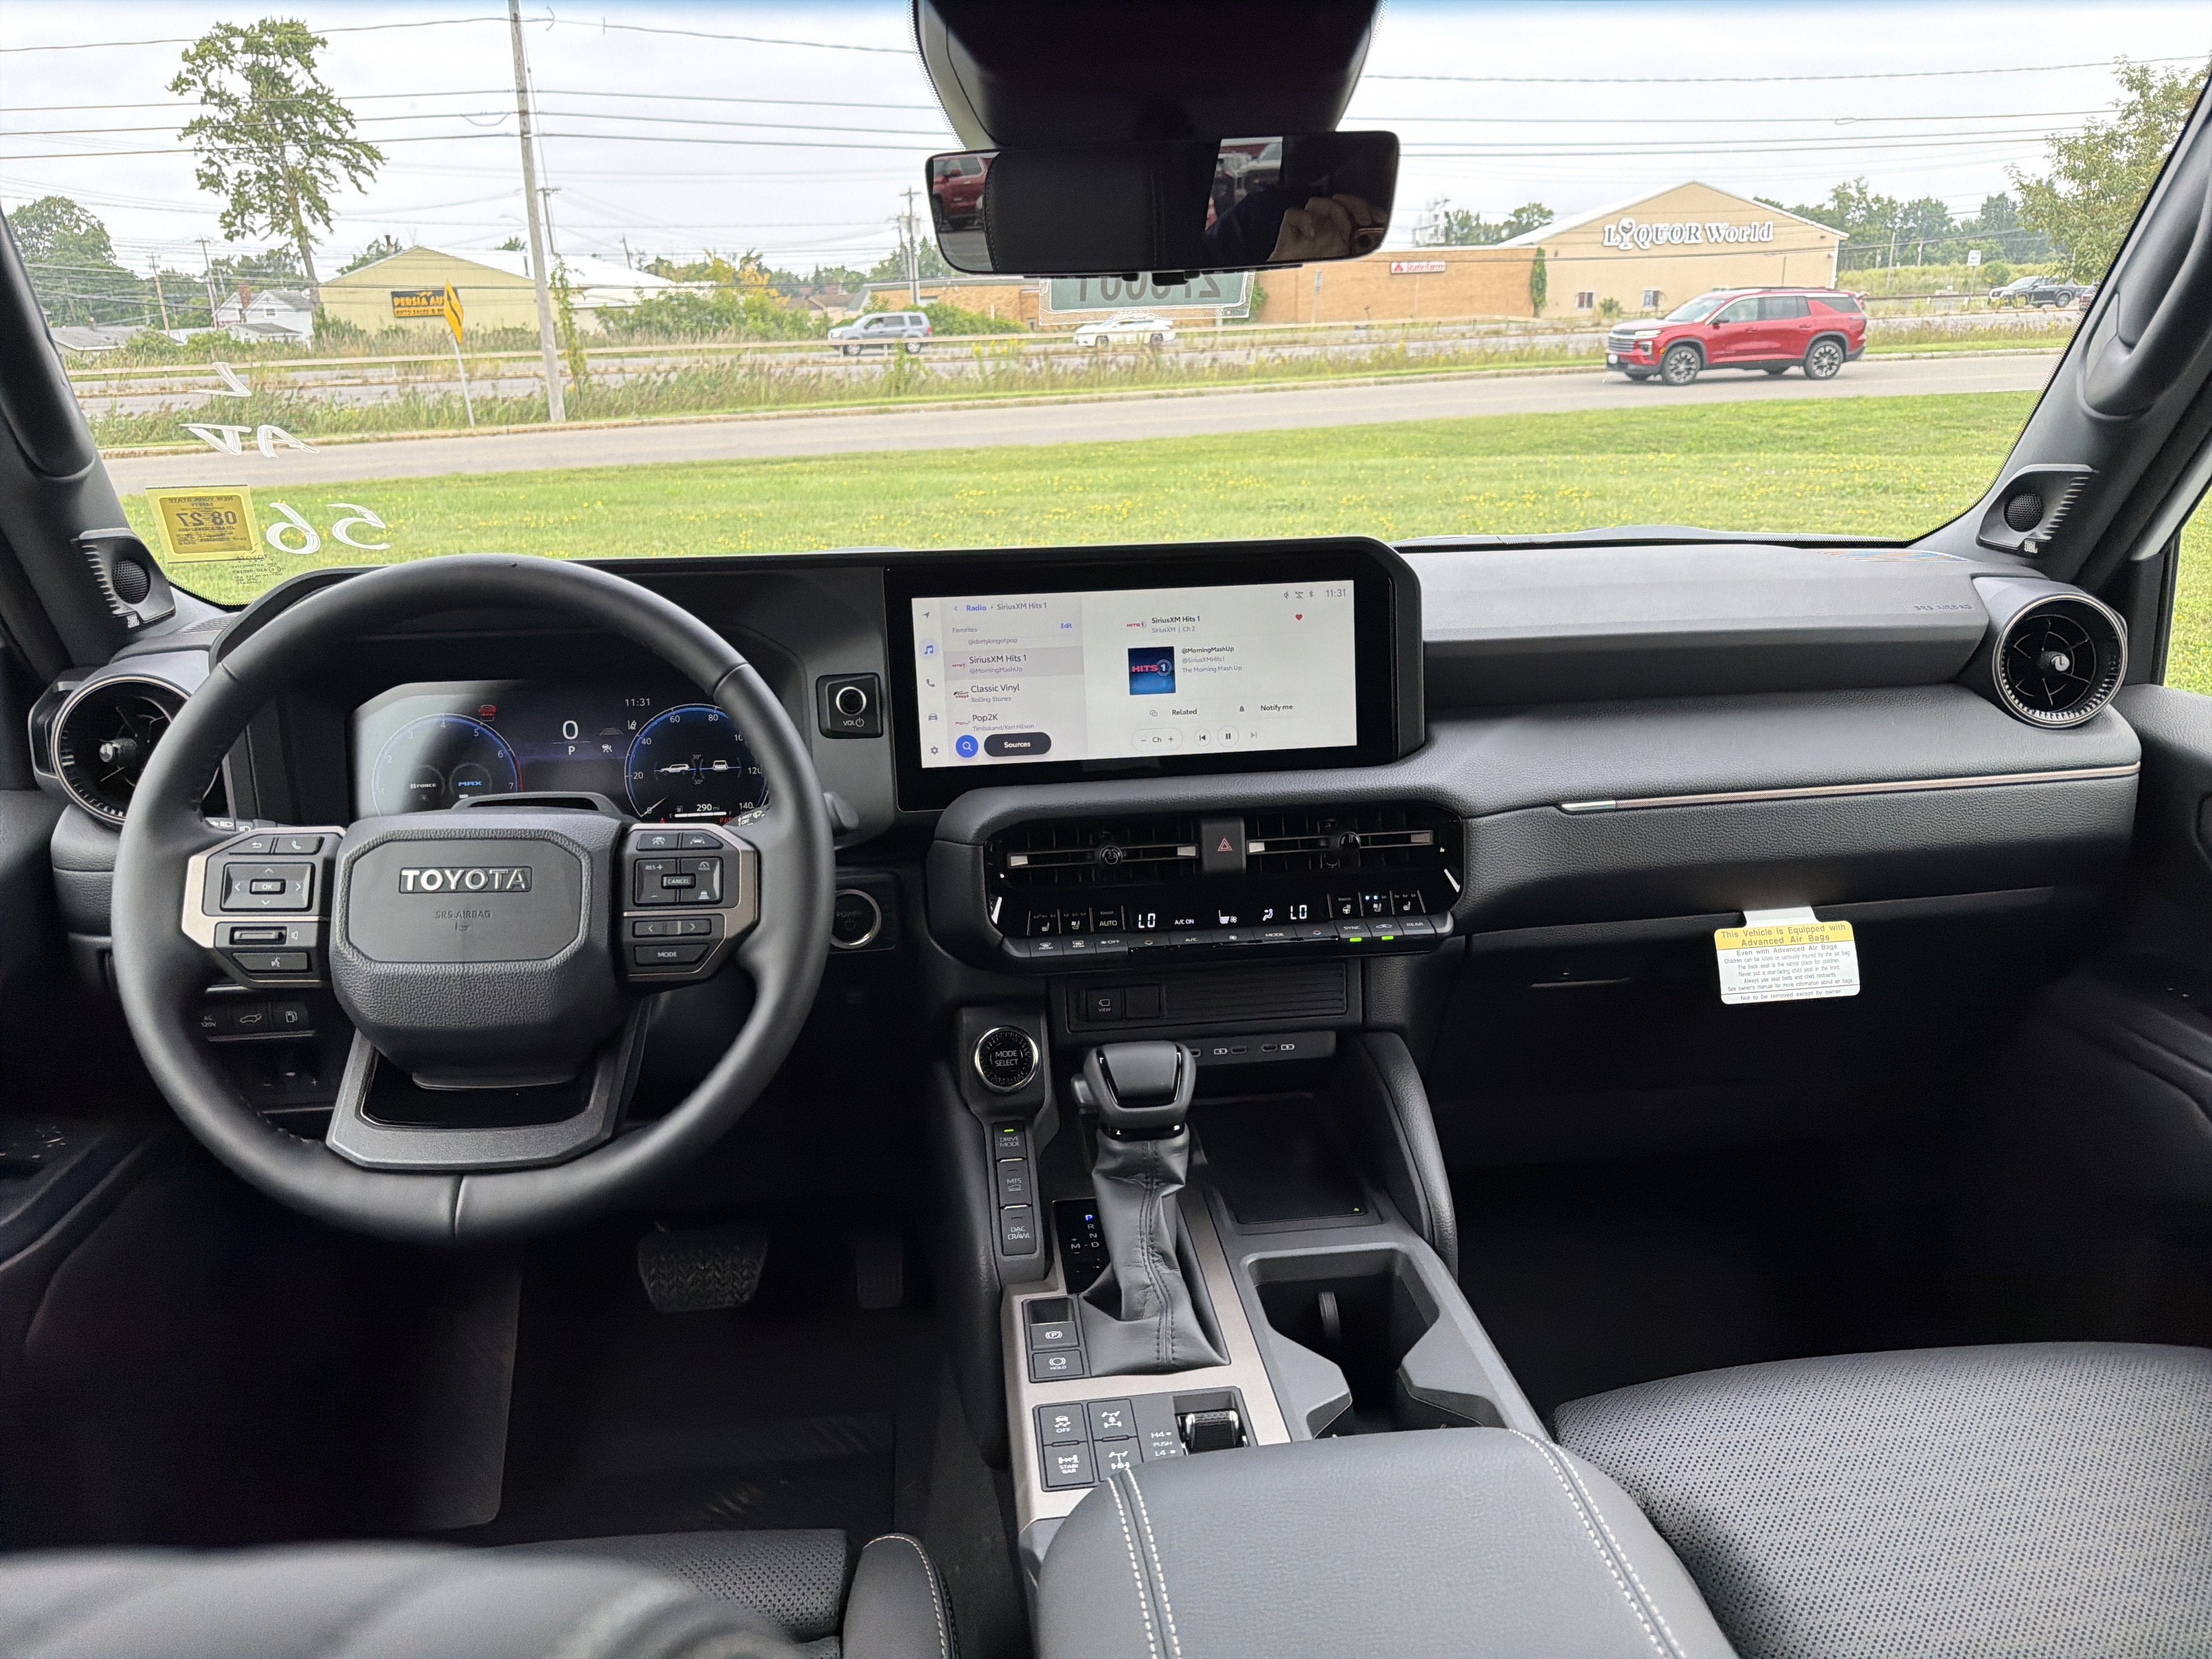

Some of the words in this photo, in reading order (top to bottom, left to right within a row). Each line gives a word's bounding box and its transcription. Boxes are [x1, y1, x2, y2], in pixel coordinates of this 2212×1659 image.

[1705, 221, 1774, 242] World
[2024, 541, 2038, 554] JBL
[1325, 589, 1346, 598] 11:31
[127, 614, 140, 628] JBL
[1181, 646, 1234, 654] @MorningMashUp
[969, 656, 1003, 664] SiriusXM
[1132, 664, 1159, 673] HITS
[970, 684, 998, 693] Classic
[1000, 683, 1020, 692] Vinyl
[624, 698, 650, 707] 11:31
[1172, 708, 1198, 716] Related
[1260, 704, 1281, 713] Notify
[972, 713, 998, 723] Pop2K
[562, 720, 579, 740] 0
[498, 750, 504, 758] 6
[568, 746, 575, 755] P
[402, 868, 528, 891] TOYOTA
[455, 910, 491, 919] AIRBAG
[1742, 927, 1773, 937] Vehicle
[1787, 925, 1825, 935] Equipped
[1741, 936, 1784, 947] Advanced
[1790, 935, 1803, 944] Air
[995, 1050, 1018, 1058] MODE
[995, 1059, 1019, 1067] SELECT
